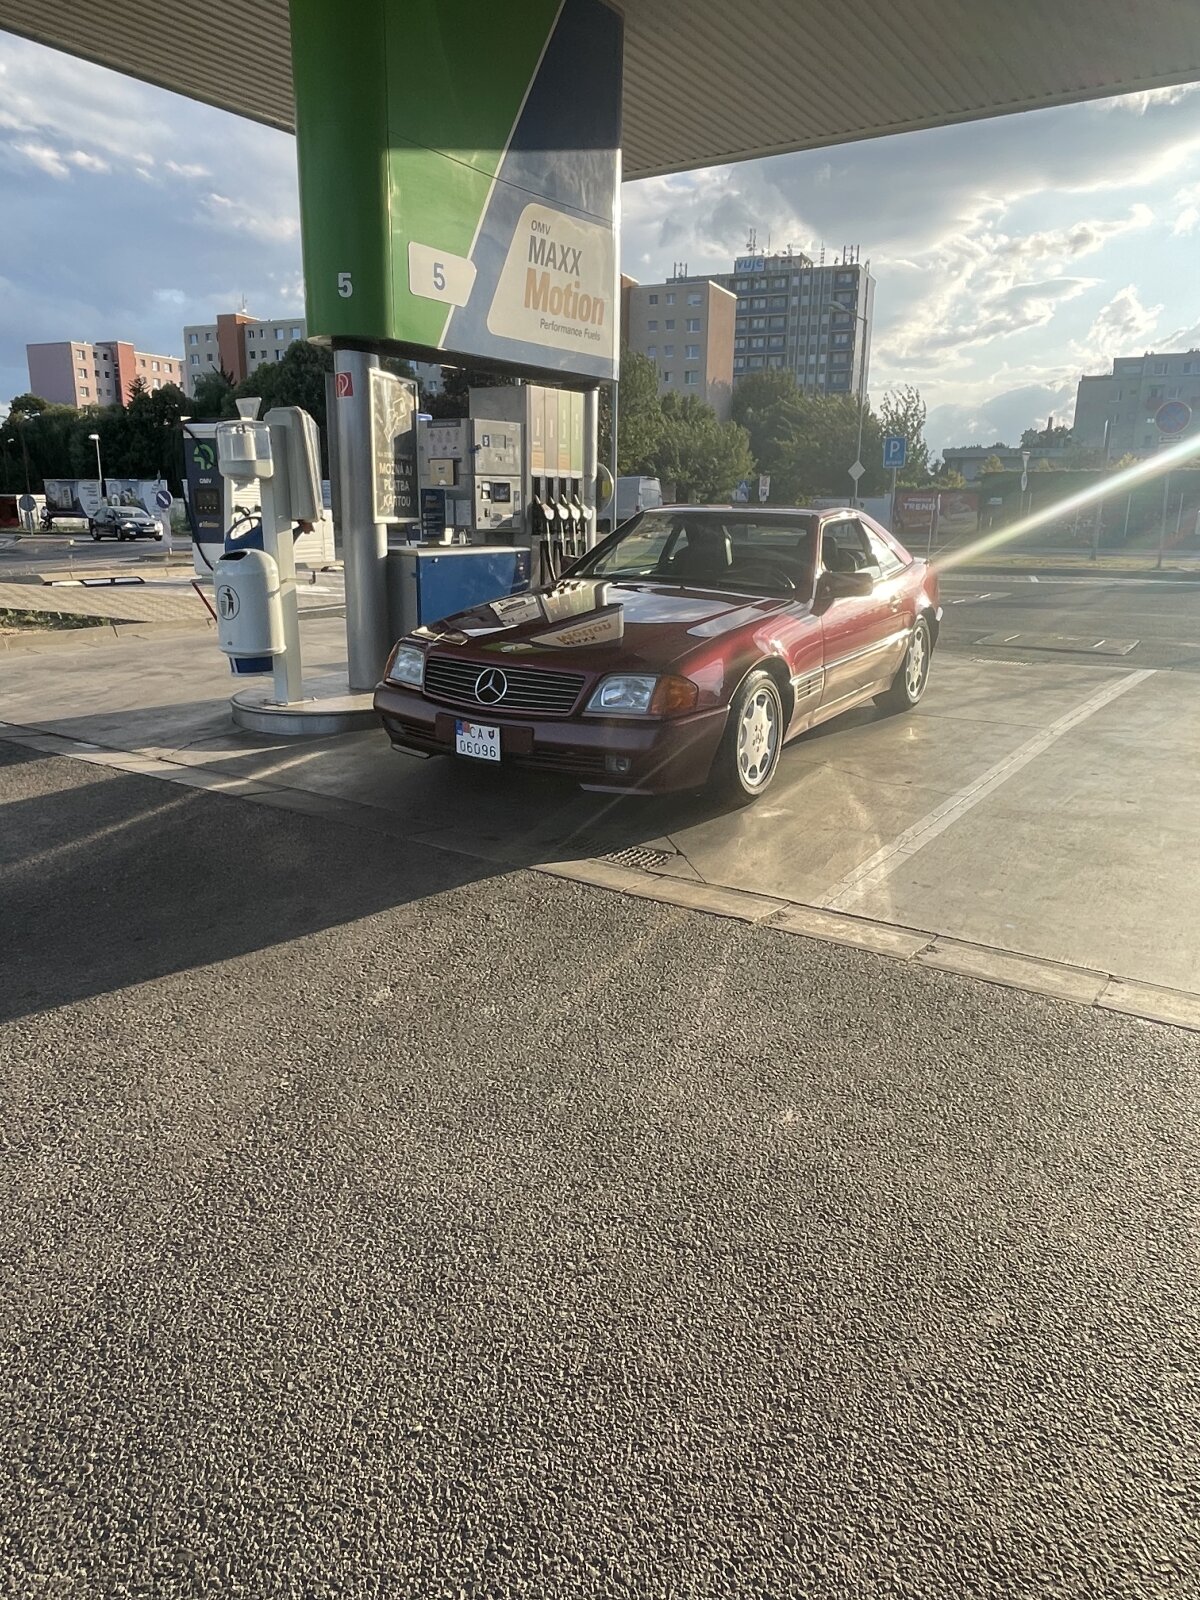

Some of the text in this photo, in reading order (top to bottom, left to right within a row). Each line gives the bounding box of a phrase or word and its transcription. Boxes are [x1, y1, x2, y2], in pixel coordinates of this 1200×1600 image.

[531, 220, 551, 235] OMV
[528, 235, 583, 276] MAXX
[737, 258, 763, 272] vuje
[337, 272, 353, 298] 5
[433, 262, 446, 291] 5
[524, 268, 605, 326] Motion
[540, 318, 601, 342] Performance Fuels
[890, 441, 900, 458] P
[379, 461, 403, 475] MOŽNÁ
[383, 478, 410, 491] PLATBA
[903, 502, 936, 511] TREND
[470, 726, 484, 740] CA
[459, 740, 497, 758] 06096
